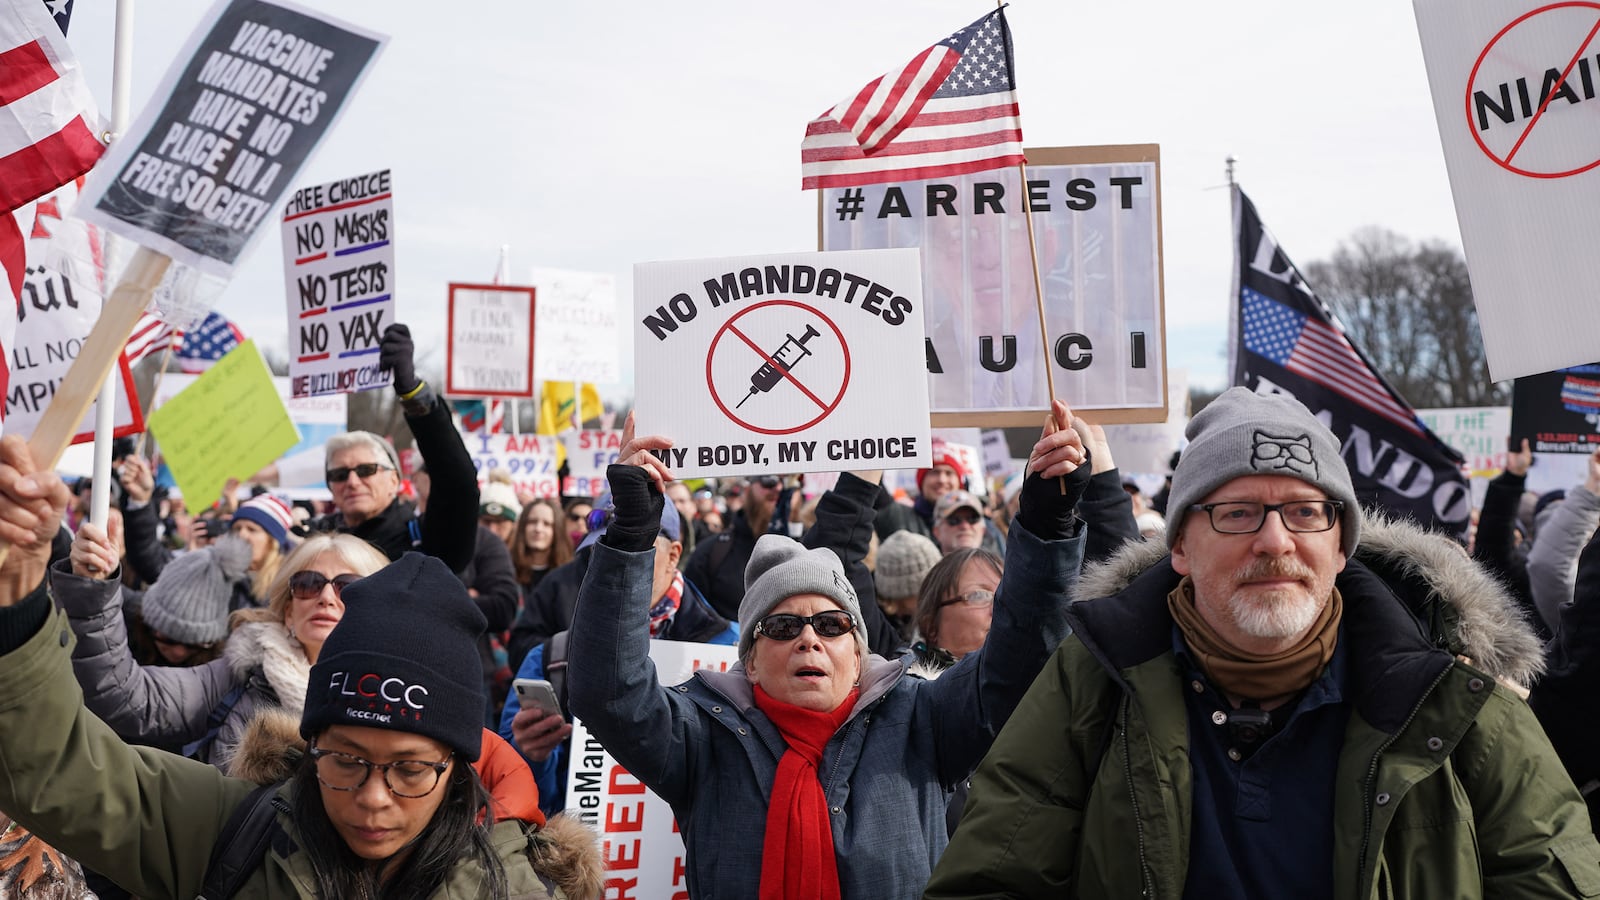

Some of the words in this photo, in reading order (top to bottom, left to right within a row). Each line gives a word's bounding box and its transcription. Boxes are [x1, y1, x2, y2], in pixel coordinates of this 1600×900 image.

[229, 21, 334, 84] VACCINE
[198, 51, 327, 125] MANDATES
[188, 89, 256, 140] HAVE
[249, 114, 293, 156] NO
[158, 122, 233, 174] PLACE
[225, 149, 264, 190] IN
[253, 163, 282, 195] A
[121, 152, 182, 198] FREE
[172, 169, 272, 234] SOCIETY
[329, 169, 391, 203] CHOICE
[836, 177, 1143, 220] #ARREST
[296, 222, 324, 254] NO
[334, 209, 388, 247] MASKS
[298, 274, 327, 310] NO
[330, 261, 387, 302] TESTS
[642, 292, 698, 341] NO
[703, 265, 913, 326] MANDATES
[301, 323, 329, 354] NO
[339, 310, 384, 350] VAX
[292, 376, 309, 396] WE
[311, 371, 337, 393] WILL
[337, 368, 357, 389] NOT
[477, 434, 493, 453] I
[505, 437, 541, 454] AM
[579, 432, 619, 449] STA
[651, 447, 688, 468] MY
[699, 444, 769, 466] BODY,
[779, 441, 817, 462] MY
[827, 437, 917, 460] CHOICE
[329, 672, 429, 709] FLCCC
[346, 707, 392, 723] flccc.net
